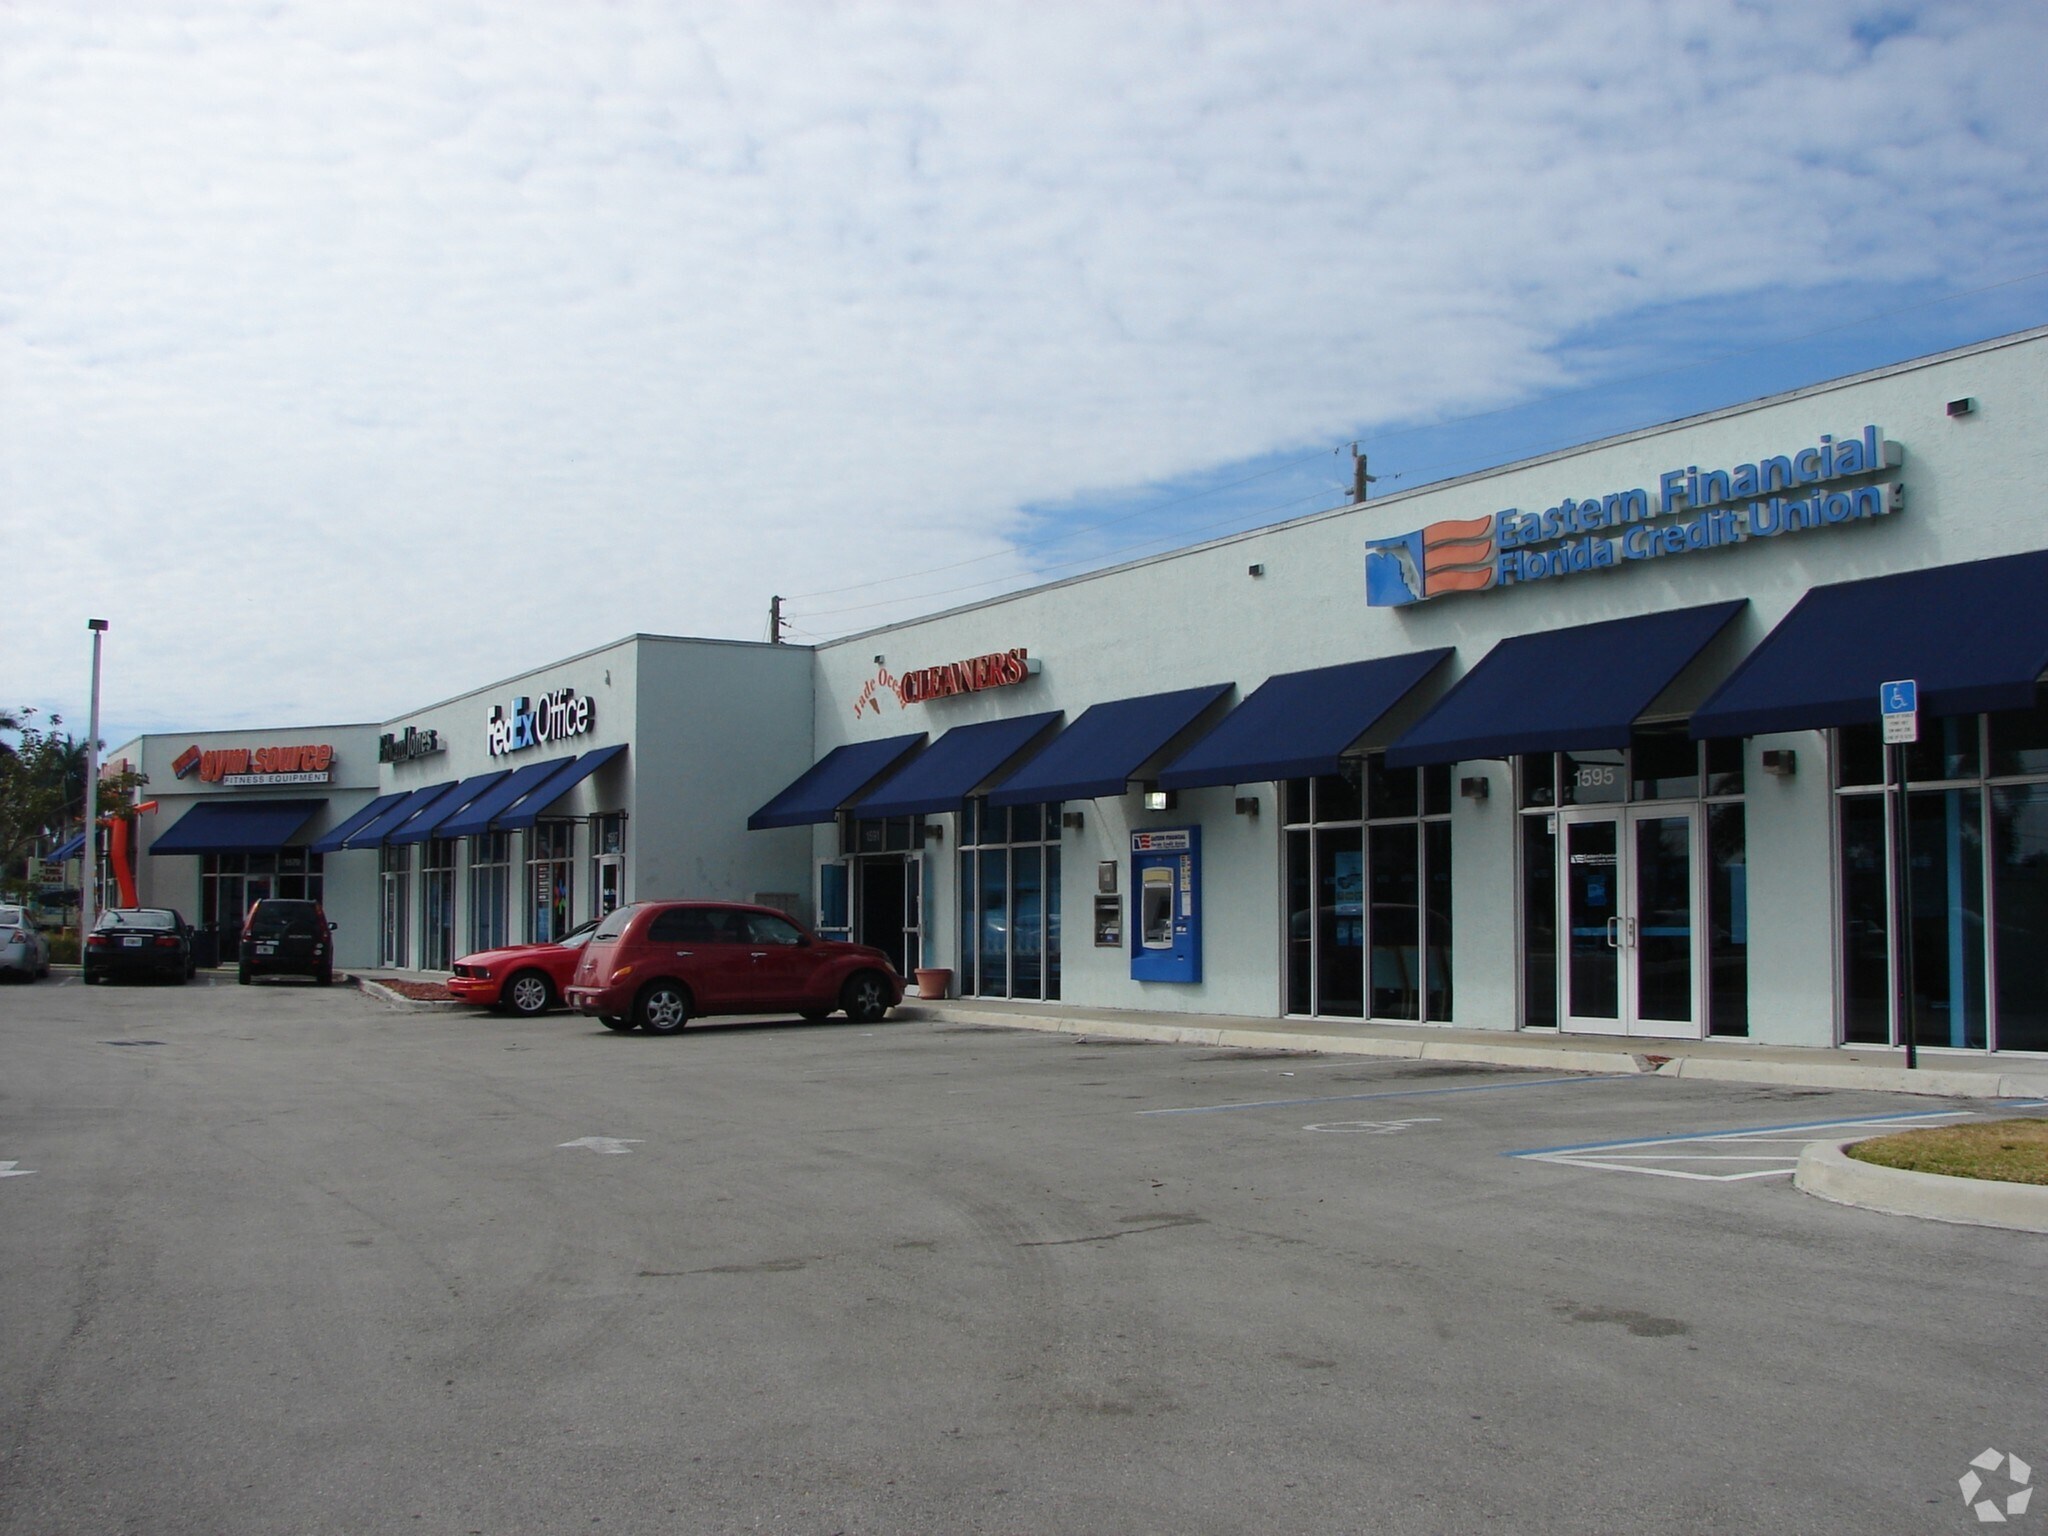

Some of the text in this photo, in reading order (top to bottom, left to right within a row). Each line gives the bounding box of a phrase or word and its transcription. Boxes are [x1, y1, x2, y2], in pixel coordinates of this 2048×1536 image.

[1495, 425, 1881, 549] Eastern Financial
[1498, 483, 1882, 585] Florida Credit Union
[487, 688, 595, 757] FedEx Office
[200, 749, 250, 782] gym
[252, 744, 331, 774] source
[224, 773, 328, 784] FITNESS EQUIPMENT
[1574, 766, 1614, 787] 1595
